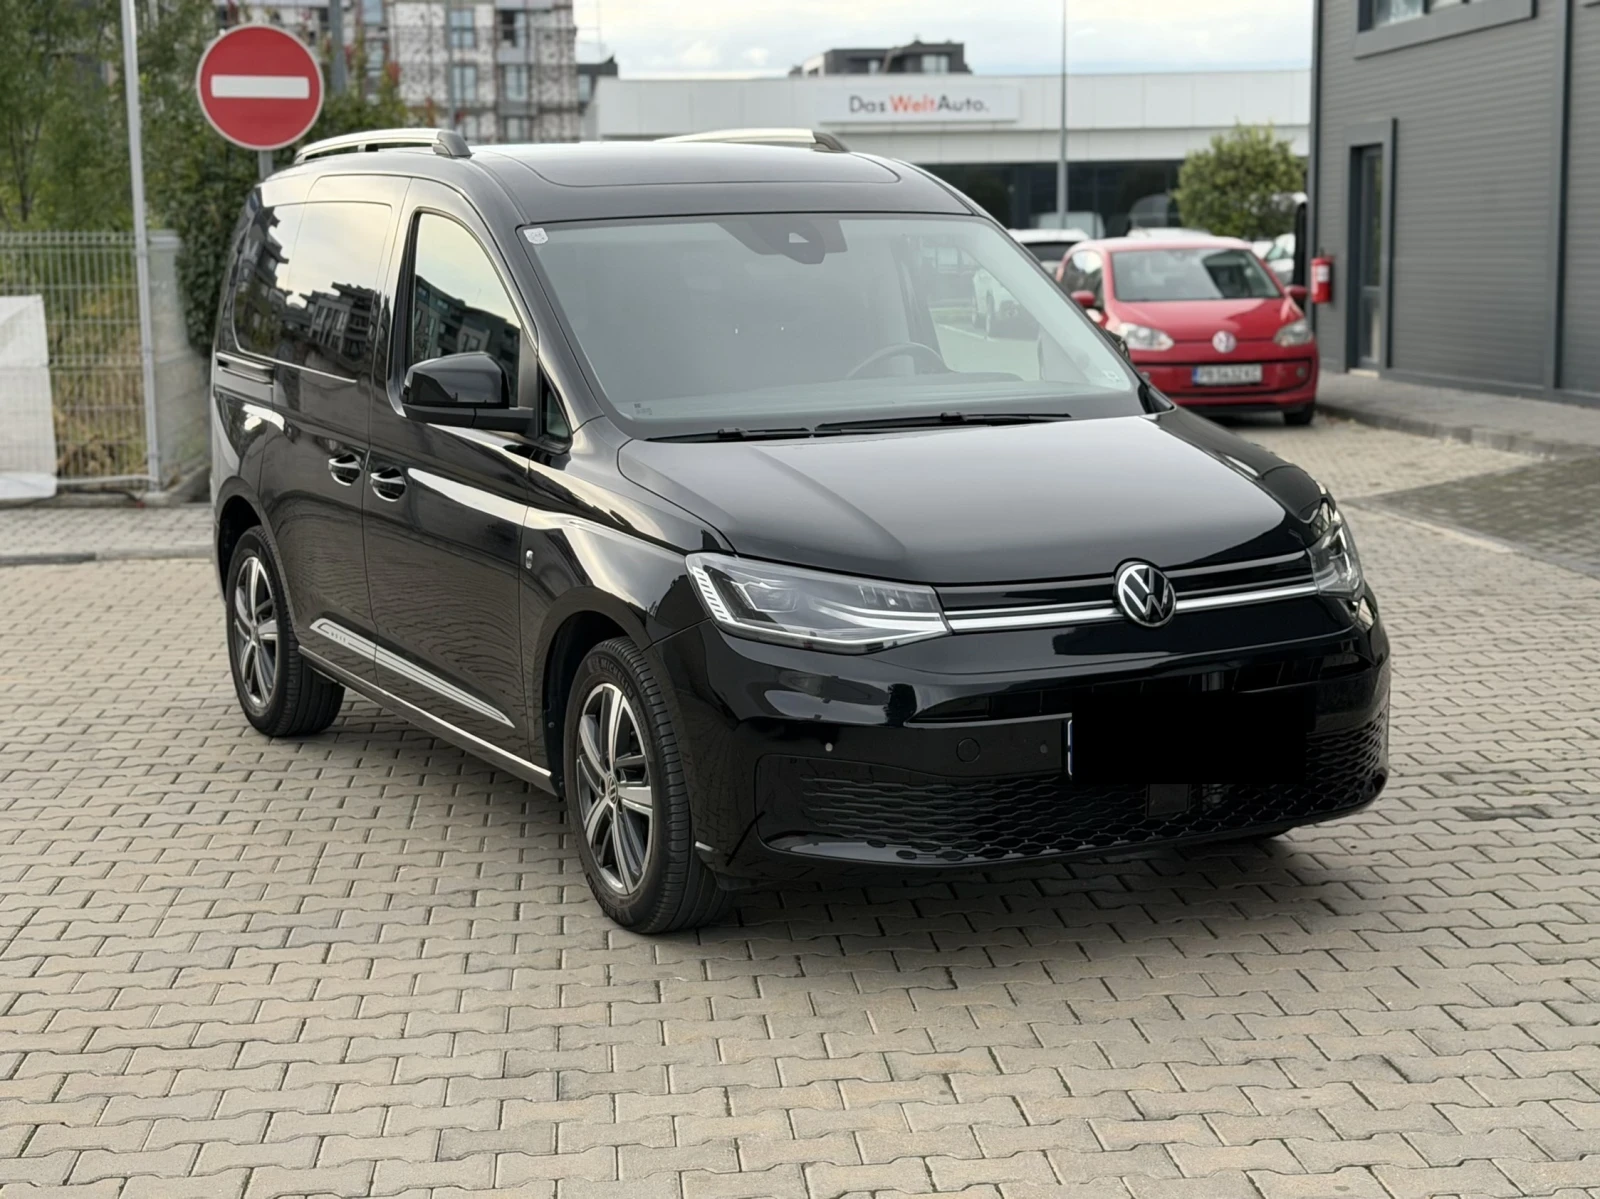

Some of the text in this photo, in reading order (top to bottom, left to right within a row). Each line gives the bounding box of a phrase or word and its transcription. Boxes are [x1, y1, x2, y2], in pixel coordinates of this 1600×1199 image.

[849, 93, 990, 113] Das WeltAuto.
[1118, 564, 1176, 628] VW
